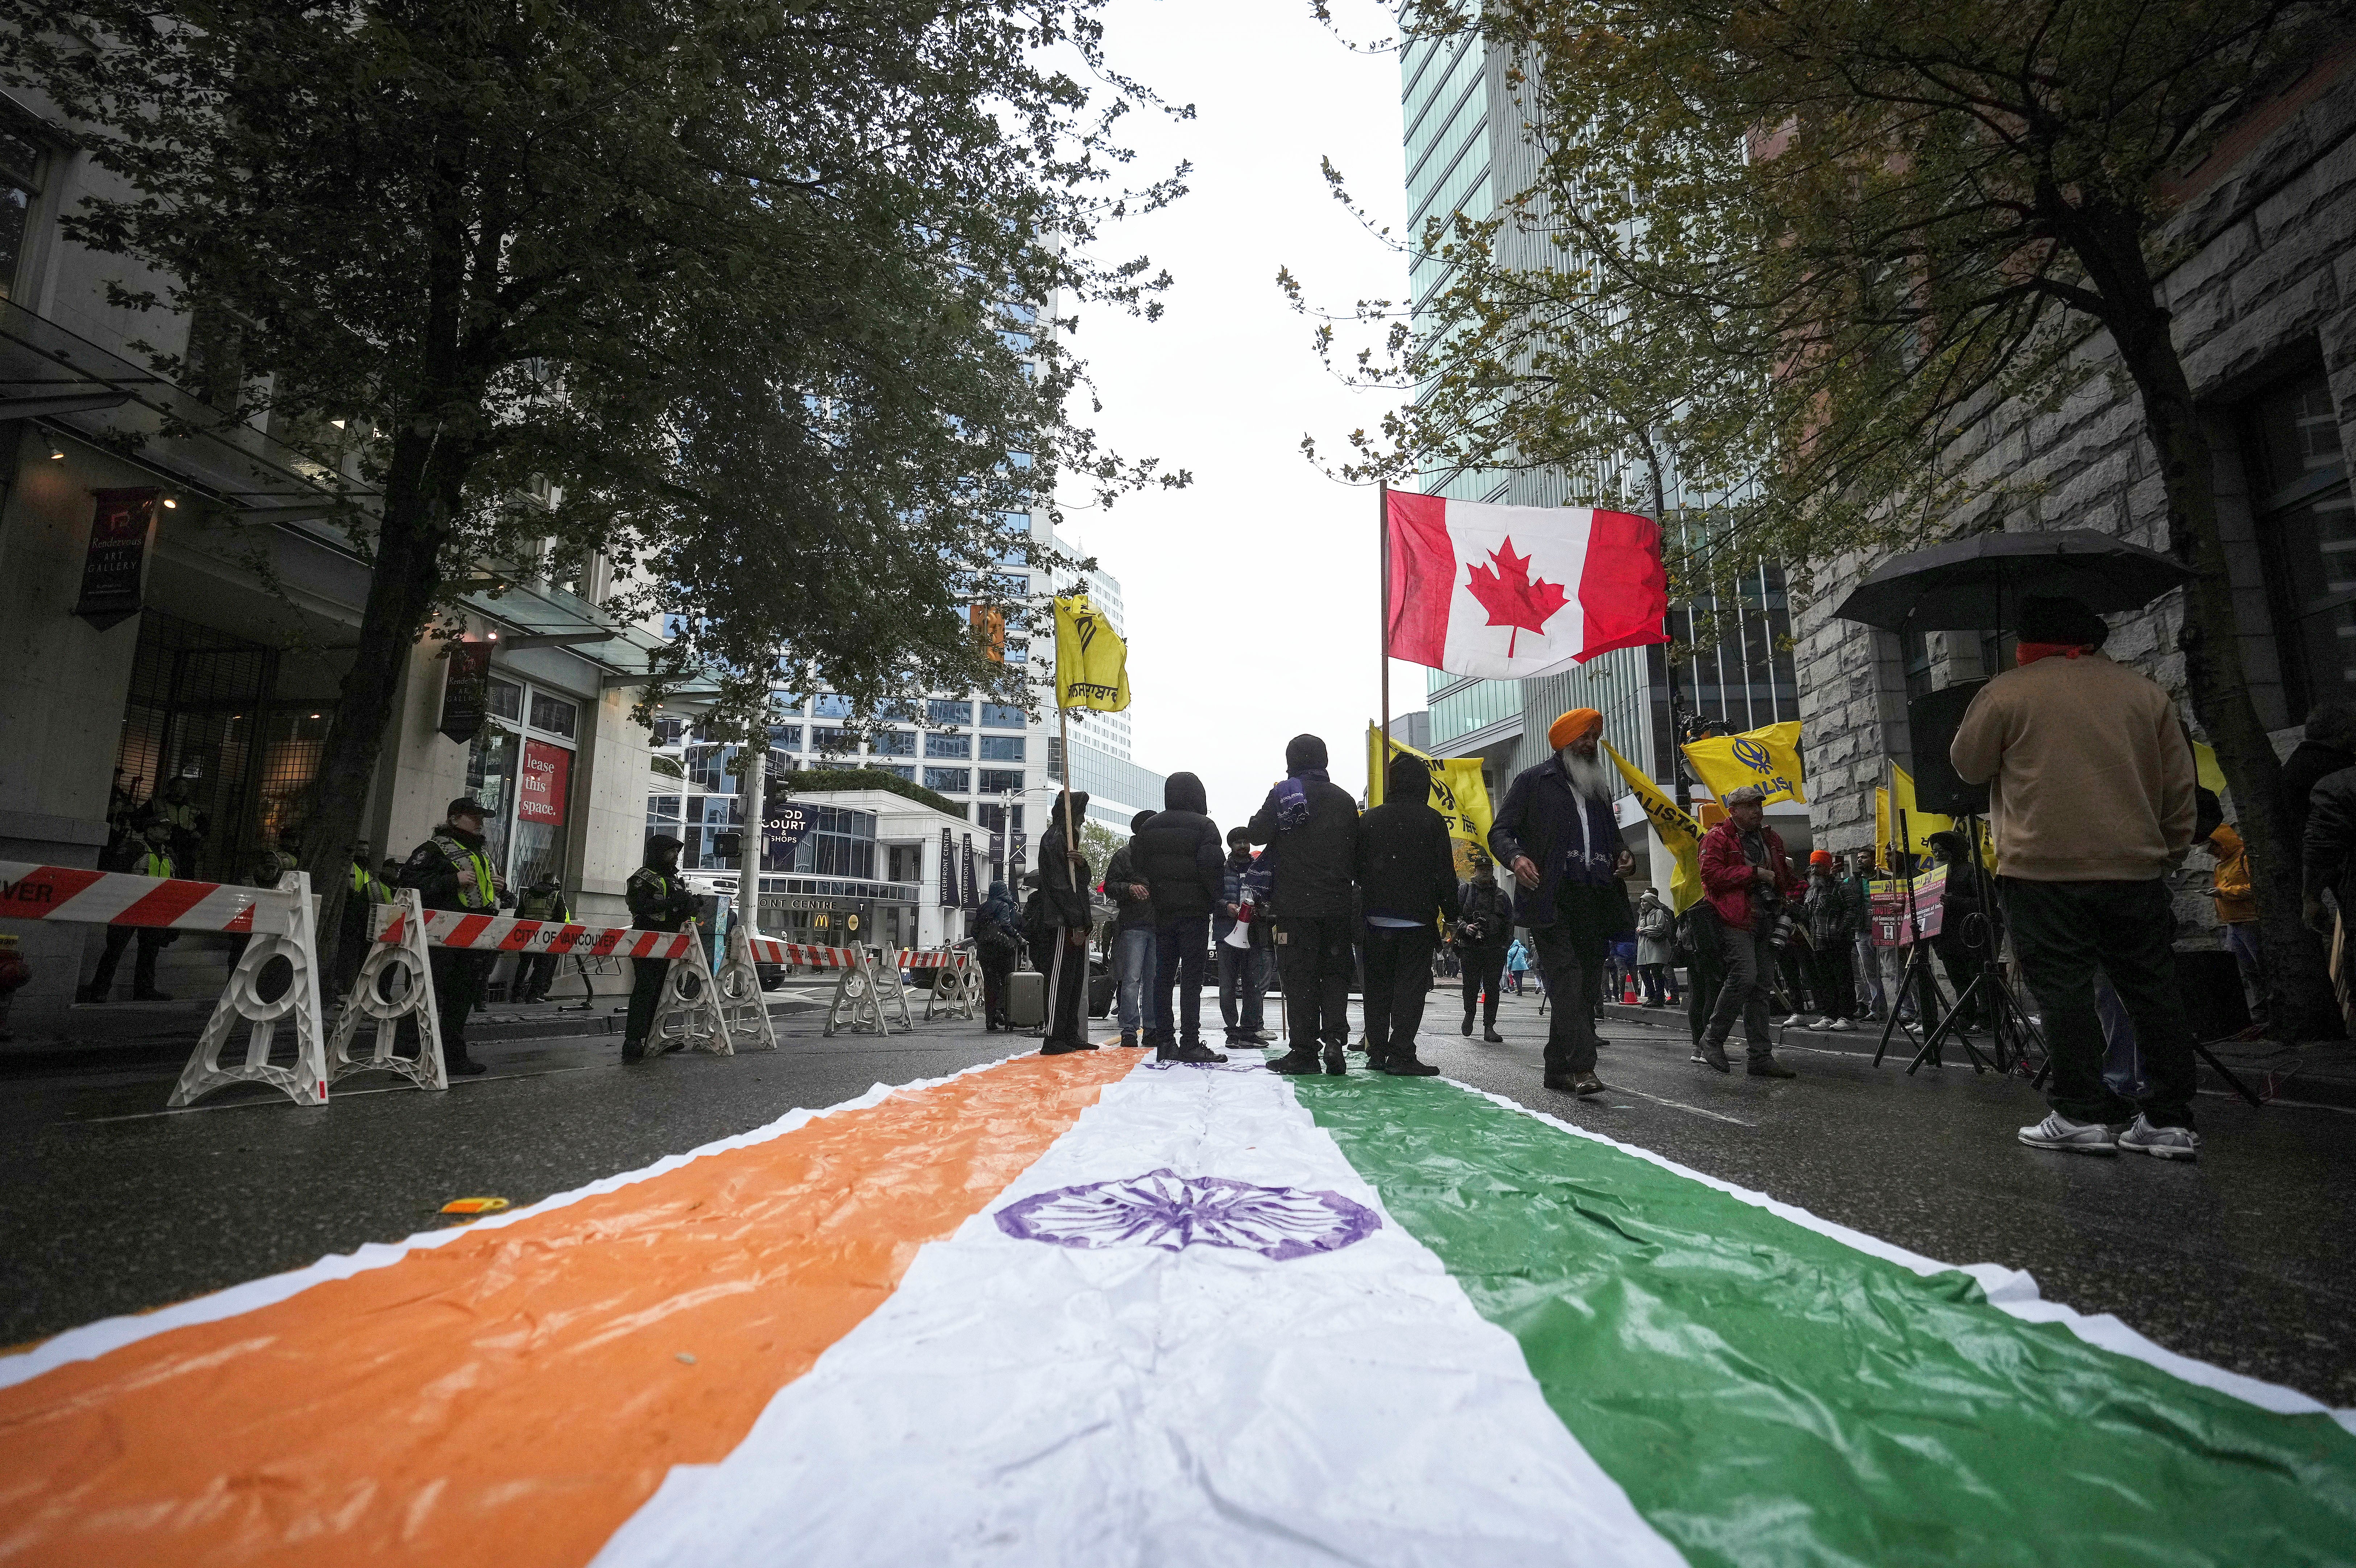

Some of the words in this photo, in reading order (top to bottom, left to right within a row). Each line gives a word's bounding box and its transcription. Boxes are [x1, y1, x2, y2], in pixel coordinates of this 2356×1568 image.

[92, 537, 141, 548] Rendezvous
[104, 552, 123, 561] ART
[88, 559, 138, 573] GALLERY
[489, 688, 511, 709] RT
[527, 754, 555, 773] lease
[526, 775, 546, 793] this
[522, 800, 556, 816] space.
[784, 809, 803, 820] OD
[1629, 785, 1705, 842] ALISTA
[3, 880, 53, 903] VER
[1914, 883, 1937, 894] SSASSINATION
[759, 899, 786, 908] ONT
[791, 900, 837, 909] CENTRE
[514, 928, 539, 943] CITY
[543, 930, 556, 944] OF
[559, 932, 615, 947] VANCOUVER
